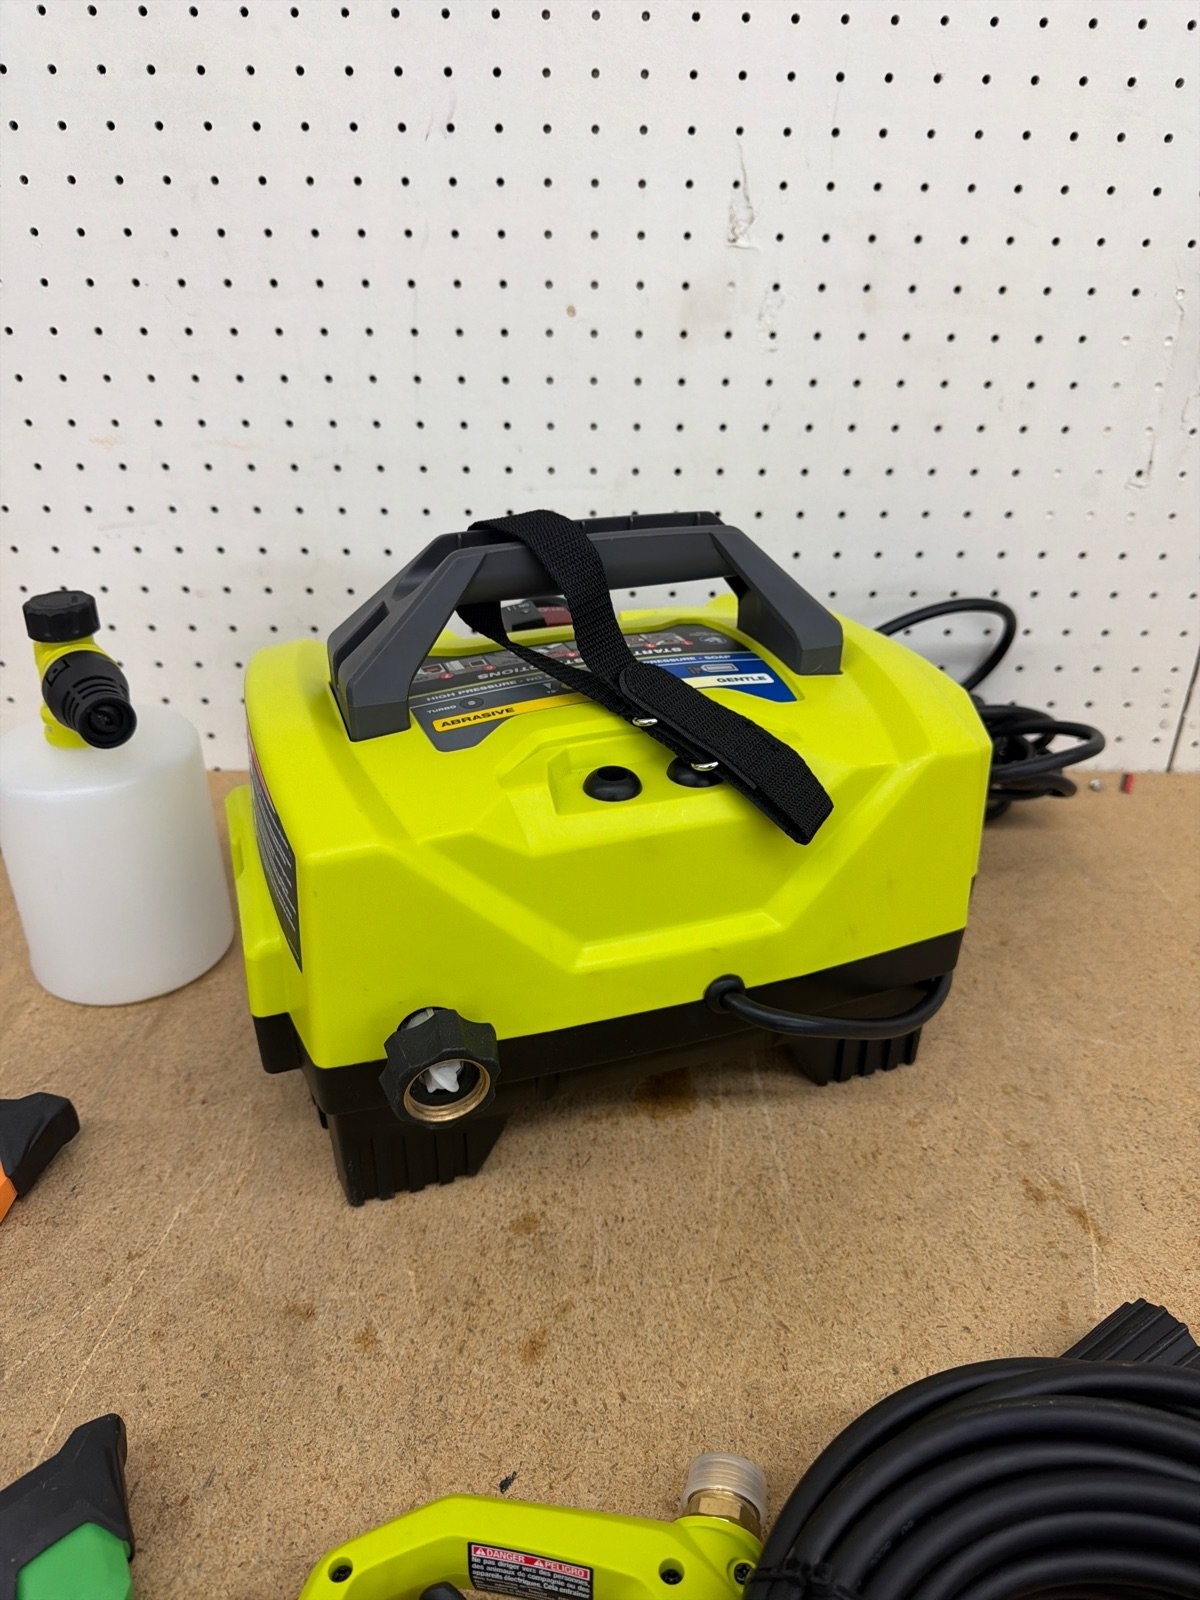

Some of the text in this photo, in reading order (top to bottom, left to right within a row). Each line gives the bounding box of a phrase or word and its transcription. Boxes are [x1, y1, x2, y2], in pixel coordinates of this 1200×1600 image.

[717, 675, 767, 683] GENTLE
[427, 692, 455, 701] HIGH
[458, 681, 517, 695] PRESSURE
[426, 704, 457, 714] TURBO
[441, 707, 515, 728] ABRASIVE
[486, 1549, 585, 1577] DANGER PELIGRO
